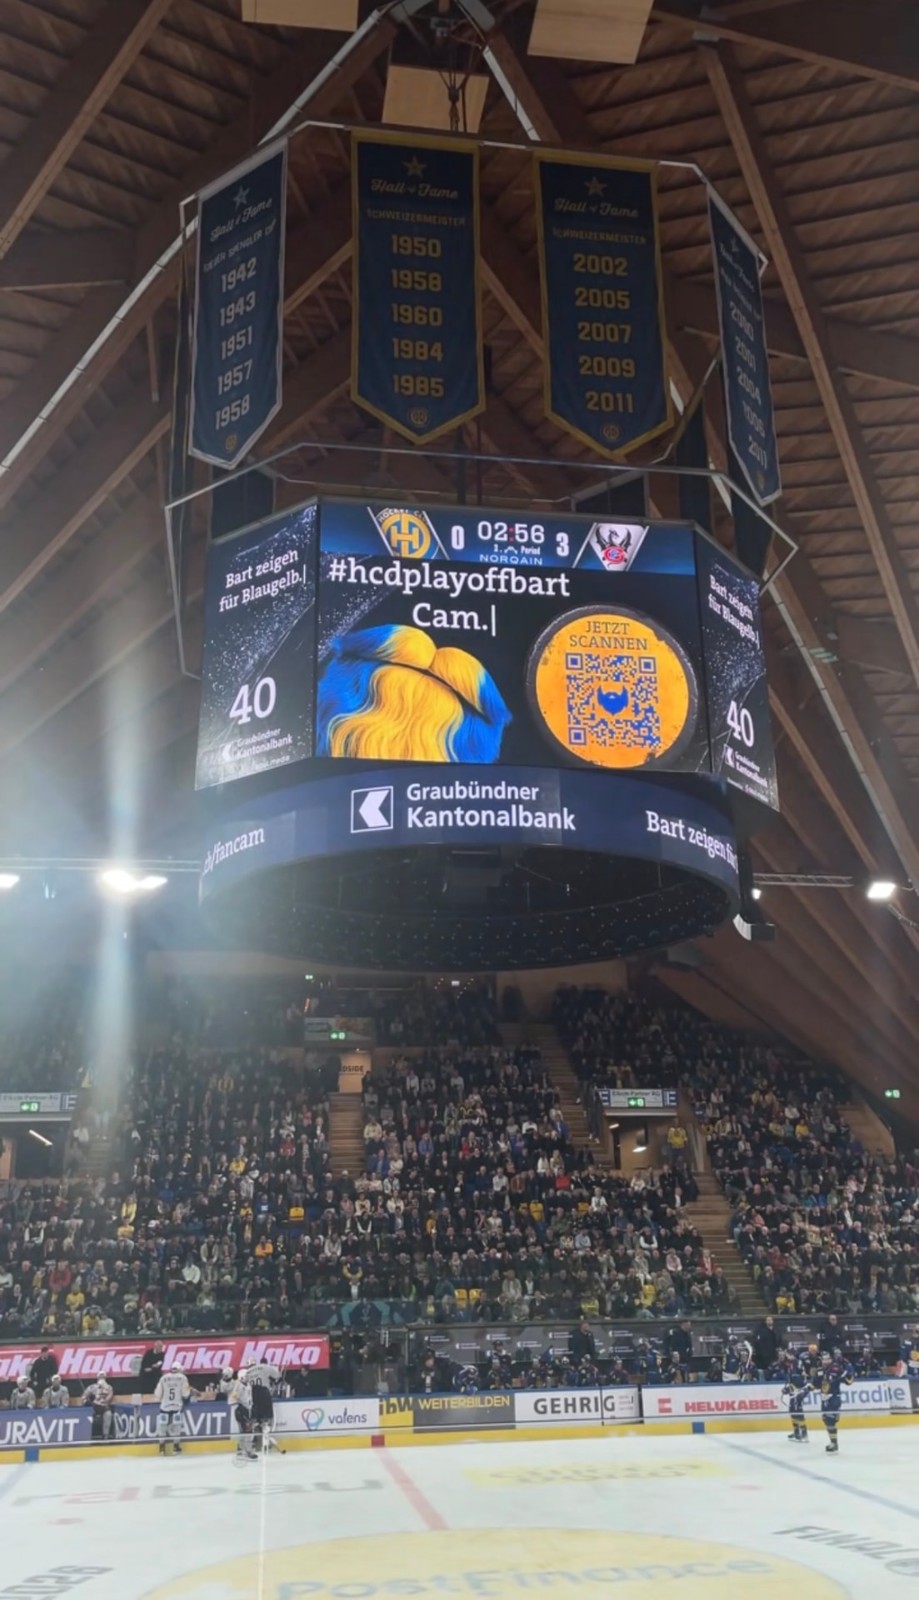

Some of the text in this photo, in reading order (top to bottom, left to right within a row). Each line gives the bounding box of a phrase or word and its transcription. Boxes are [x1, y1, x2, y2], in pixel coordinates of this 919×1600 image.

[418, 183, 459, 200] Fame
[599, 202, 640, 219] Fame
[391, 234, 442, 258] 1950
[221, 257, 257, 292] 1942
[573, 253, 628, 277] 2002
[391, 268, 442, 292] 1958
[220, 292, 256, 327] 1943
[574, 287, 630, 310] 2005
[391, 303, 443, 327] 1960
[221, 326, 253, 360] 1951
[577, 321, 632, 344] 2007
[392, 337, 444, 362] 1984
[217, 359, 253, 395] 1957
[579, 356, 636, 379] 2009
[393, 374, 445, 398] 1985
[215, 394, 250, 430] 1958
[585, 390, 634, 413] 2011
[451, 520, 570, 557] 0 02:56 3
[520, 545, 541, 556] Period
[225, 549, 299, 589] Bart zeigen
[479, 554, 544, 566] NORQAIN
[328, 557, 571, 598] #hcdplayoffbart
[218, 593, 240, 613] für
[412, 602, 489, 631] Cam.
[585, 620, 630, 636] JETZT
[569, 635, 649, 651] SCANNEN
[229, 676, 277, 725] 40
[726, 700, 755, 748] 40
[236, 734, 293, 760] Kantonalbank
[407, 780, 540, 802] Graubündner
[406, 802, 577, 833] Kantonalbank
[645, 809, 686, 841] Bart
[687, 827, 726, 859] zeigen
[239, 1340, 321, 1367] Hako
[168, 1388, 176, 1400] 5
[418, 1394, 511, 1411] WEITERBILDEN
[533, 1394, 616, 1415] GEHRIG
[684, 1398, 778, 1413] HELUKABEL
[276, 1558, 776, 1600] PostFinance
